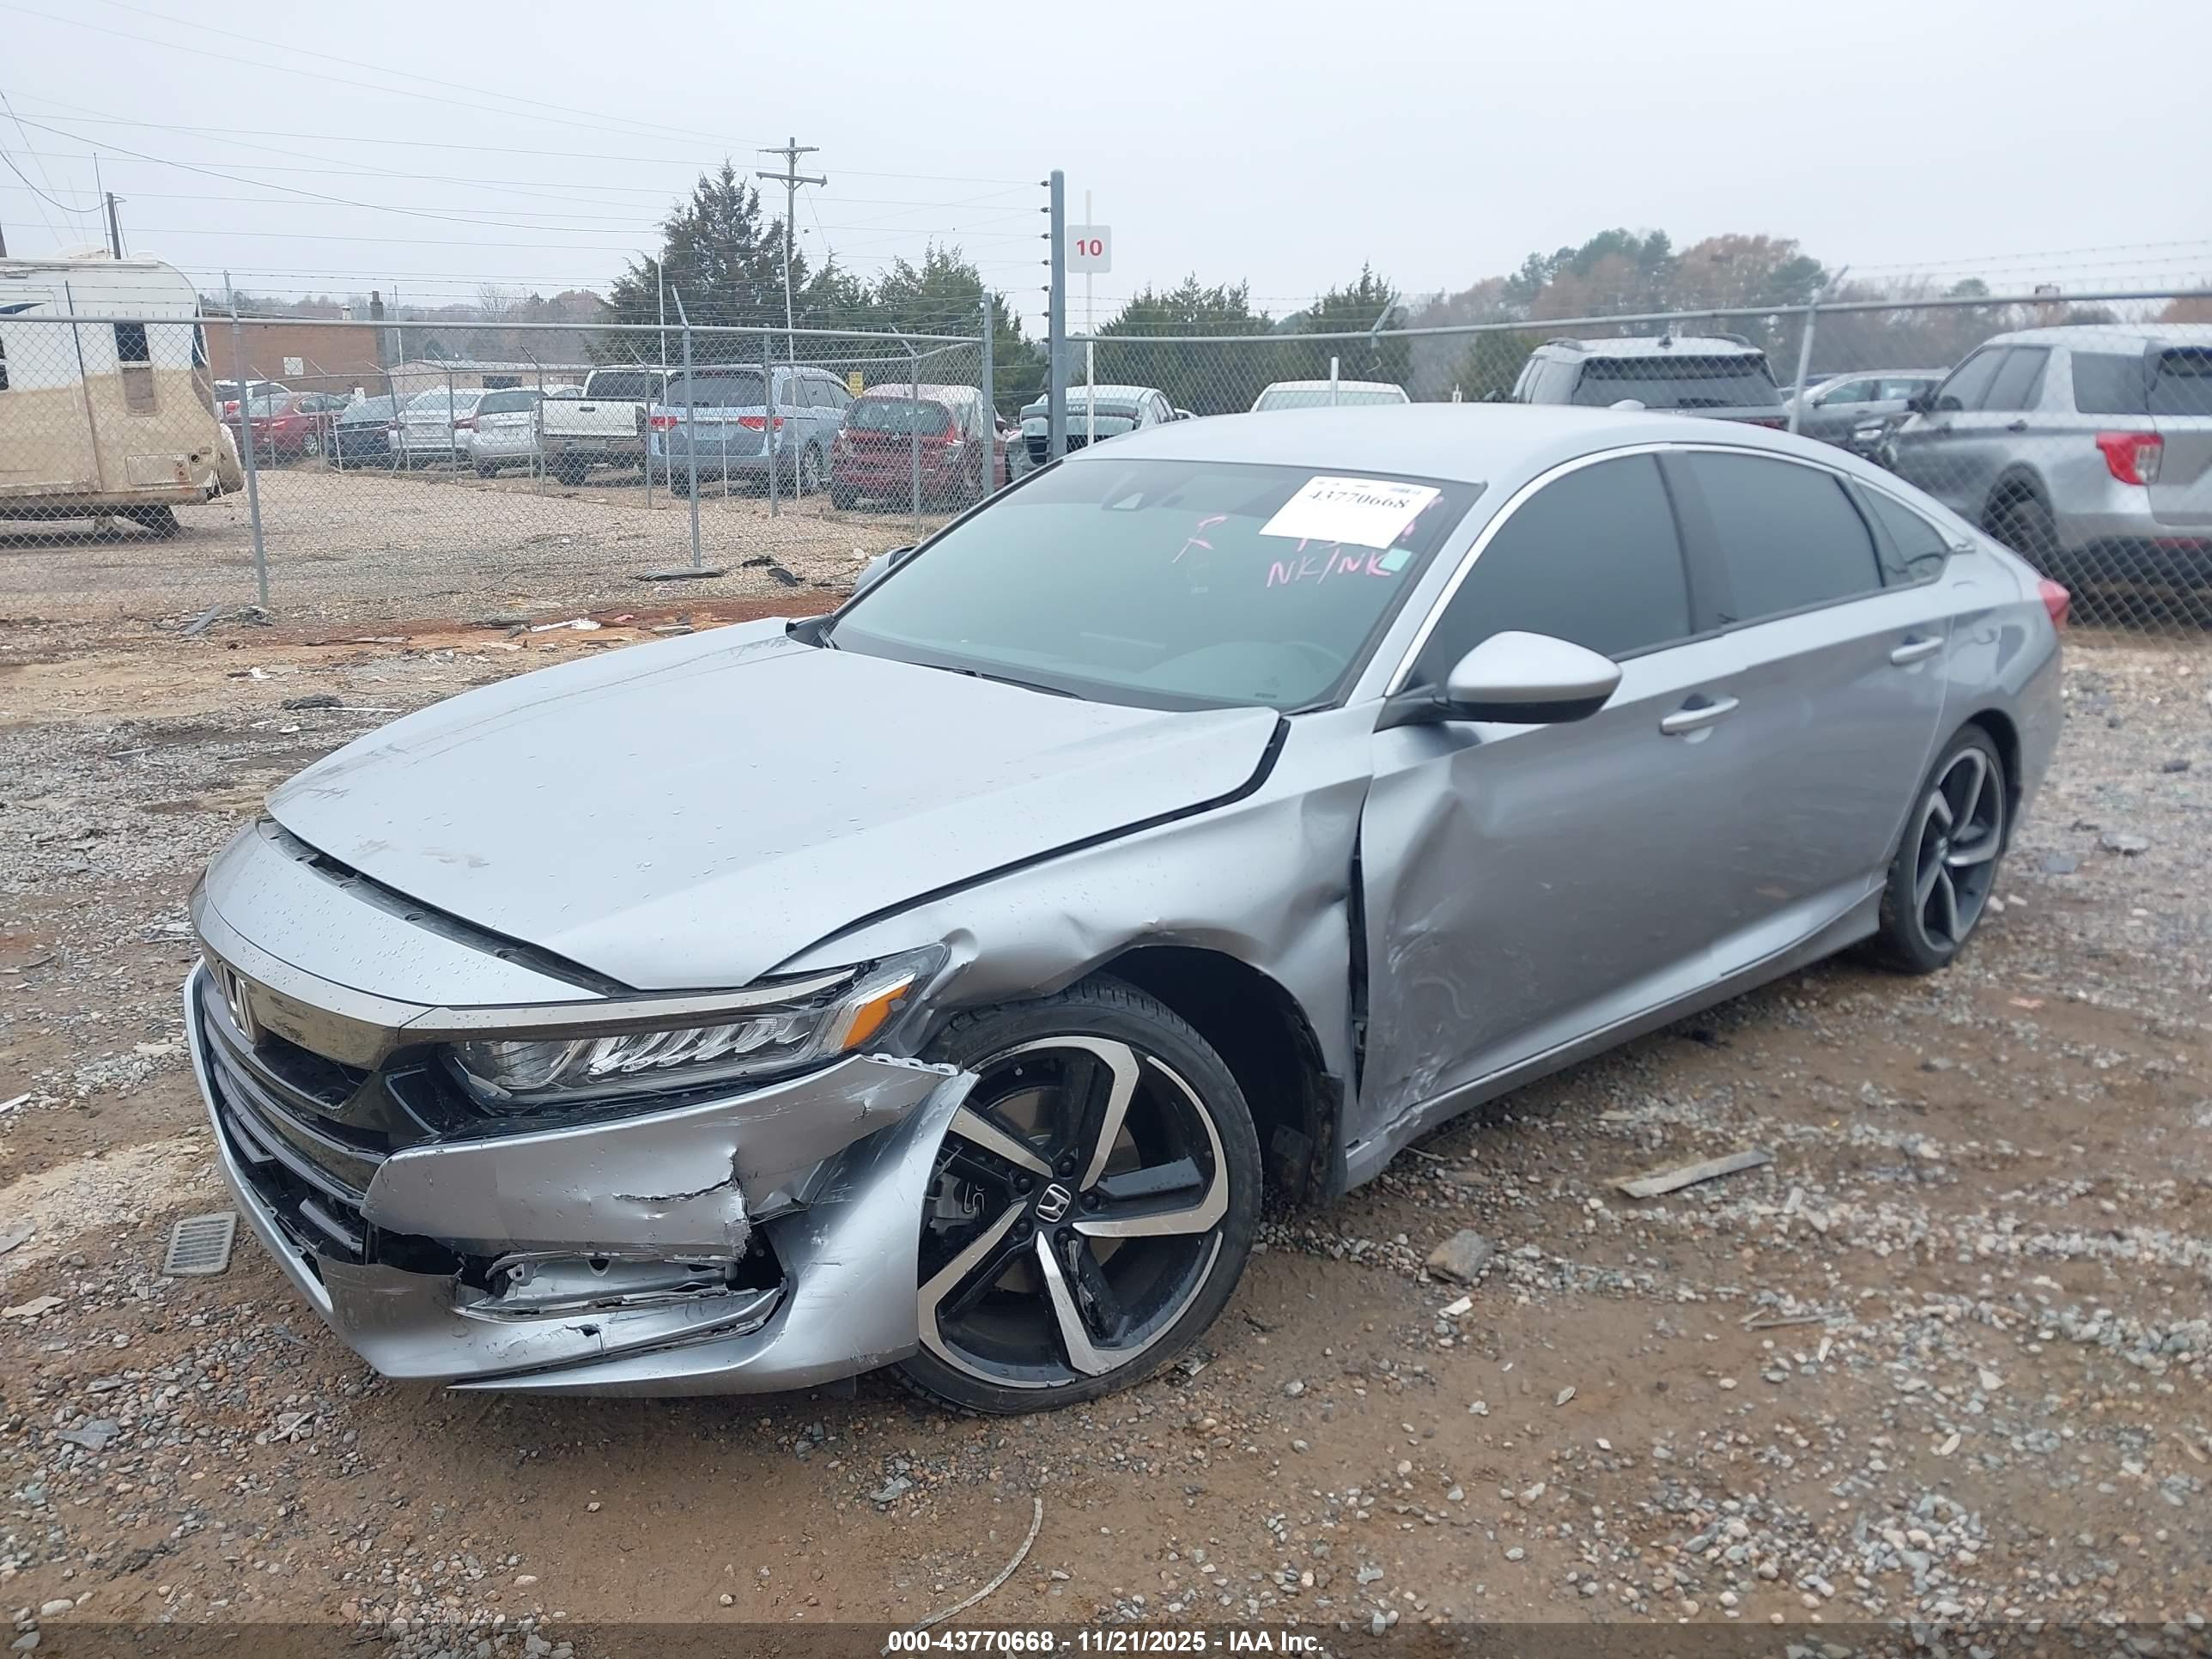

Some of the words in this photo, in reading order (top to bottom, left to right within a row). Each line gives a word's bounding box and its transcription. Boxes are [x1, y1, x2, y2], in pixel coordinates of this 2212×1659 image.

[1076, 239, 1103, 257] 10
[1309, 489, 1411, 509] 43770668
[1266, 547, 1392, 588] NK/NK
